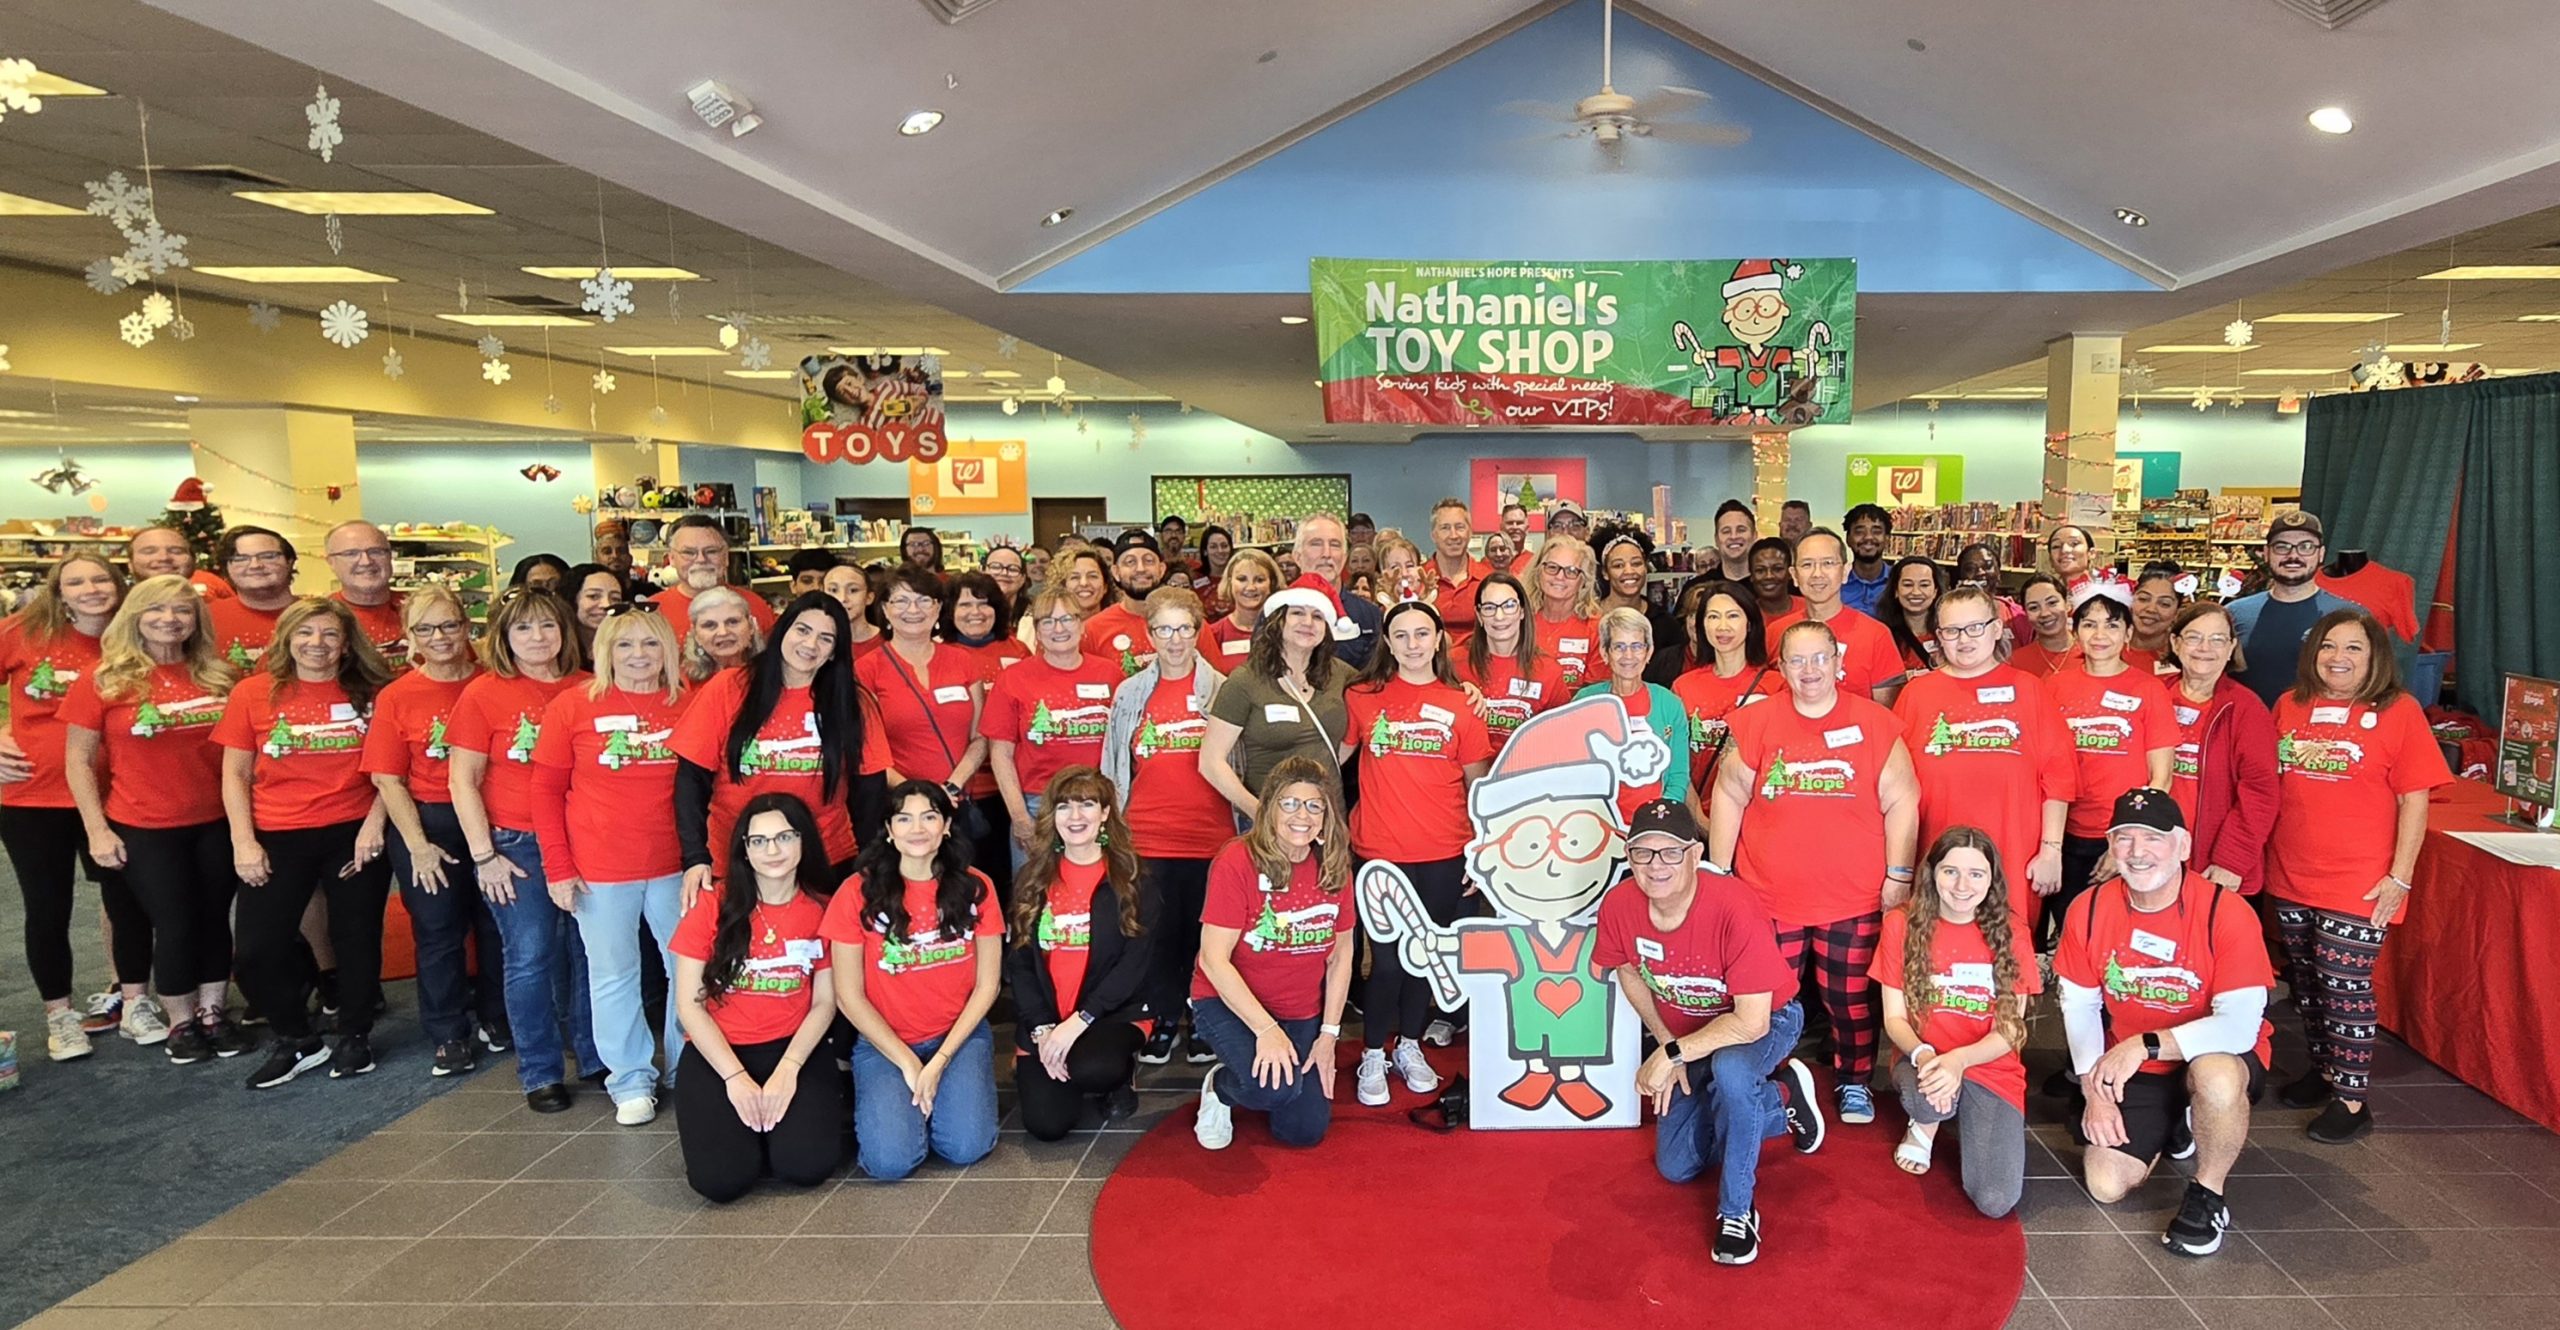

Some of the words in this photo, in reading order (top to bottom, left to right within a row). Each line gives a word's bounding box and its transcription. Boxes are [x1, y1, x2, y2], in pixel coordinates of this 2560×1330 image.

[1416, 266, 1485, 279] NATHANIEL'S
[1486, 267, 1518, 279] HOPE
[1519, 267, 1575, 280] PRESENTS
[1364, 279, 1618, 326] Nathaniel's
[1365, 326, 1466, 374] TOY
[1477, 328, 1614, 375] SHOP
[1375, 371, 1429, 397] Serving
[1434, 374, 1468, 394] kids
[1472, 374, 1511, 392] with
[1512, 376, 1568, 398] special
[1571, 375, 1616, 394] needs
[1505, 403, 1546, 418] our
[1551, 395, 1615, 421] VIPs!
[811, 430, 939, 458] TOYS
[182, 709, 225, 725] Hop
[1170, 736, 1201, 749] Hop
[1401, 738, 1442, 752] Hope
[1965, 736, 2011, 748] Hope
[2075, 733, 2119, 749] Hope
[1799, 778, 1846, 792] Hope
[1290, 927, 1334, 946] Hope
[919, 945, 966, 965] Hope
[751, 977, 800, 993] Hope
[1676, 994, 1723, 1008] Hope
[1940, 993, 1989, 1013] Hope
[2141, 985, 2189, 1004] Hope
